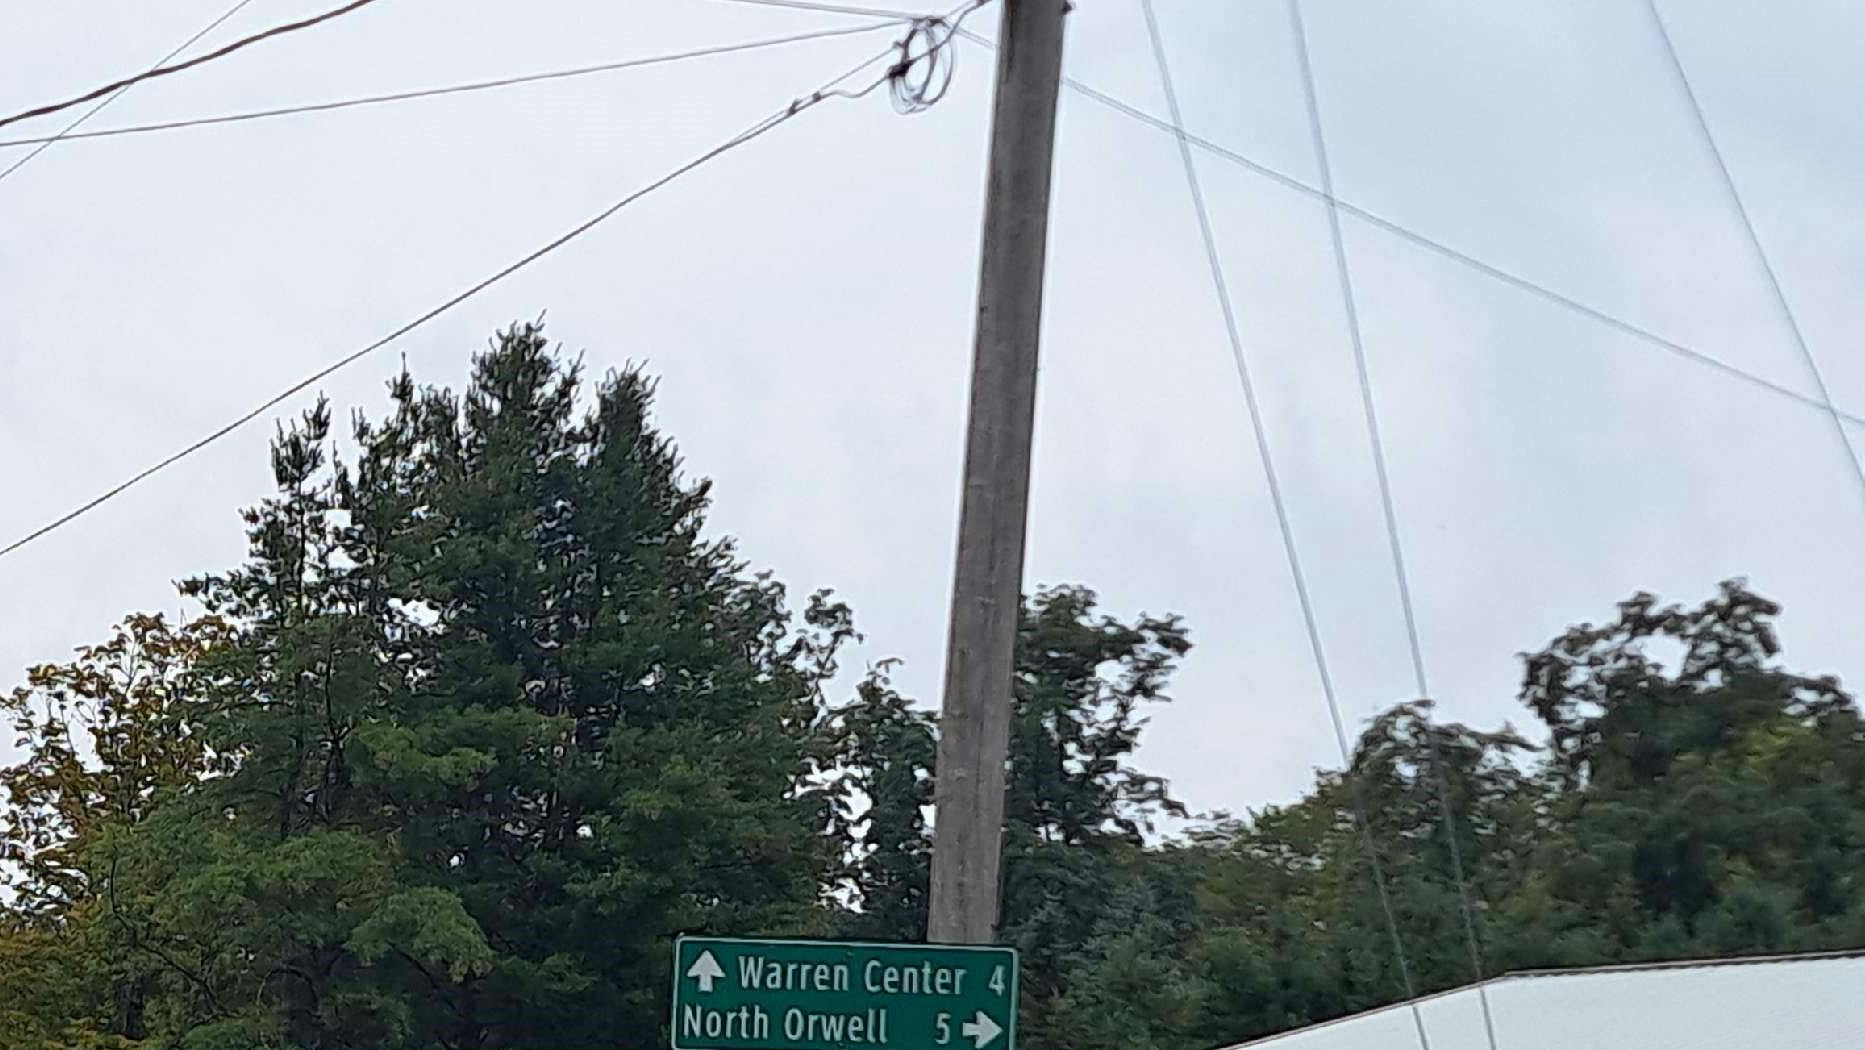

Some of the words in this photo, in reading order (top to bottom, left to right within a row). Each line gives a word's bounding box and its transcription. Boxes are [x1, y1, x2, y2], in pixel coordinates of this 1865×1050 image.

[738, 955, 849, 992] Warren
[864, 959, 966, 995] Center
[988, 965, 1005, 996] 4
[683, 1005, 769, 1040] North
[784, 1008, 888, 1043] Orwell
[936, 1013, 950, 1045] 5
